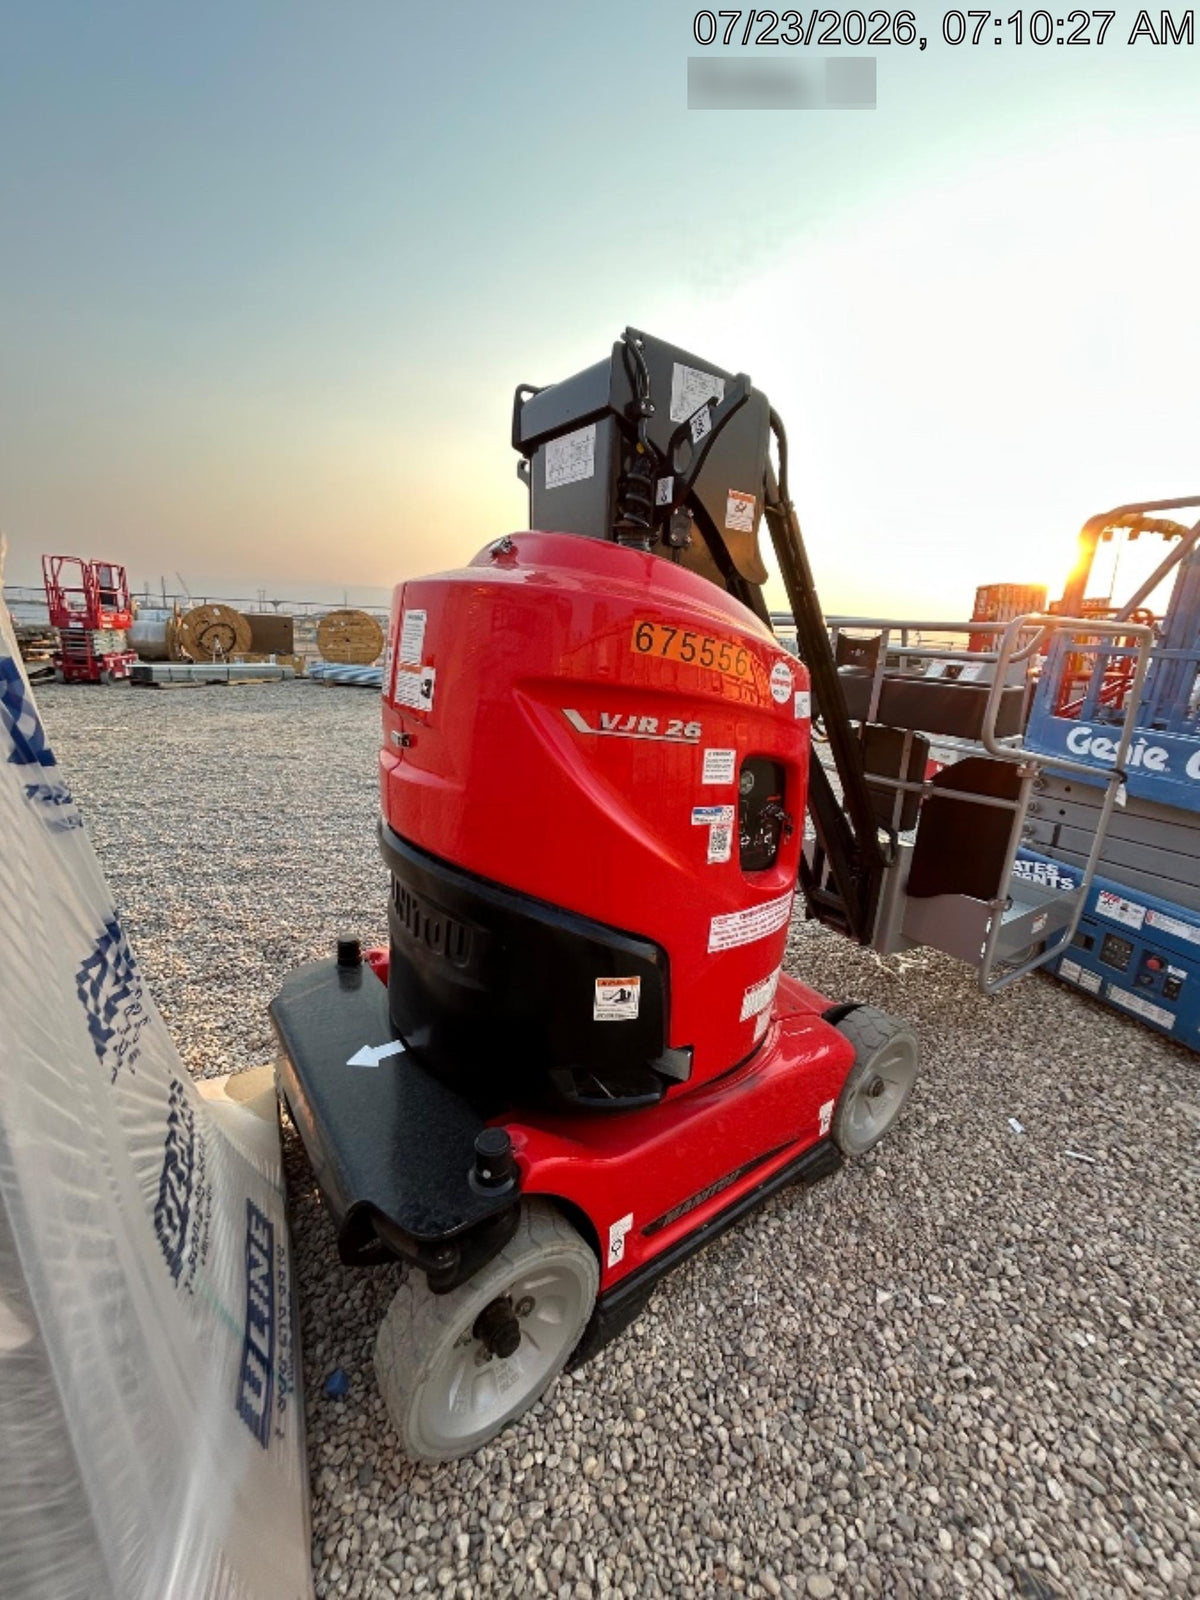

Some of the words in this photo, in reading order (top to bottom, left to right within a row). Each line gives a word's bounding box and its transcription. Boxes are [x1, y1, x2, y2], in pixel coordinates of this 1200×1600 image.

[635, 622, 748, 676] 675556
[600, 712, 659, 734] VJR
[667, 719, 702, 738] 26
[1066, 726, 1169, 772] Genie
[241, 1210, 270, 1418] ULINE
